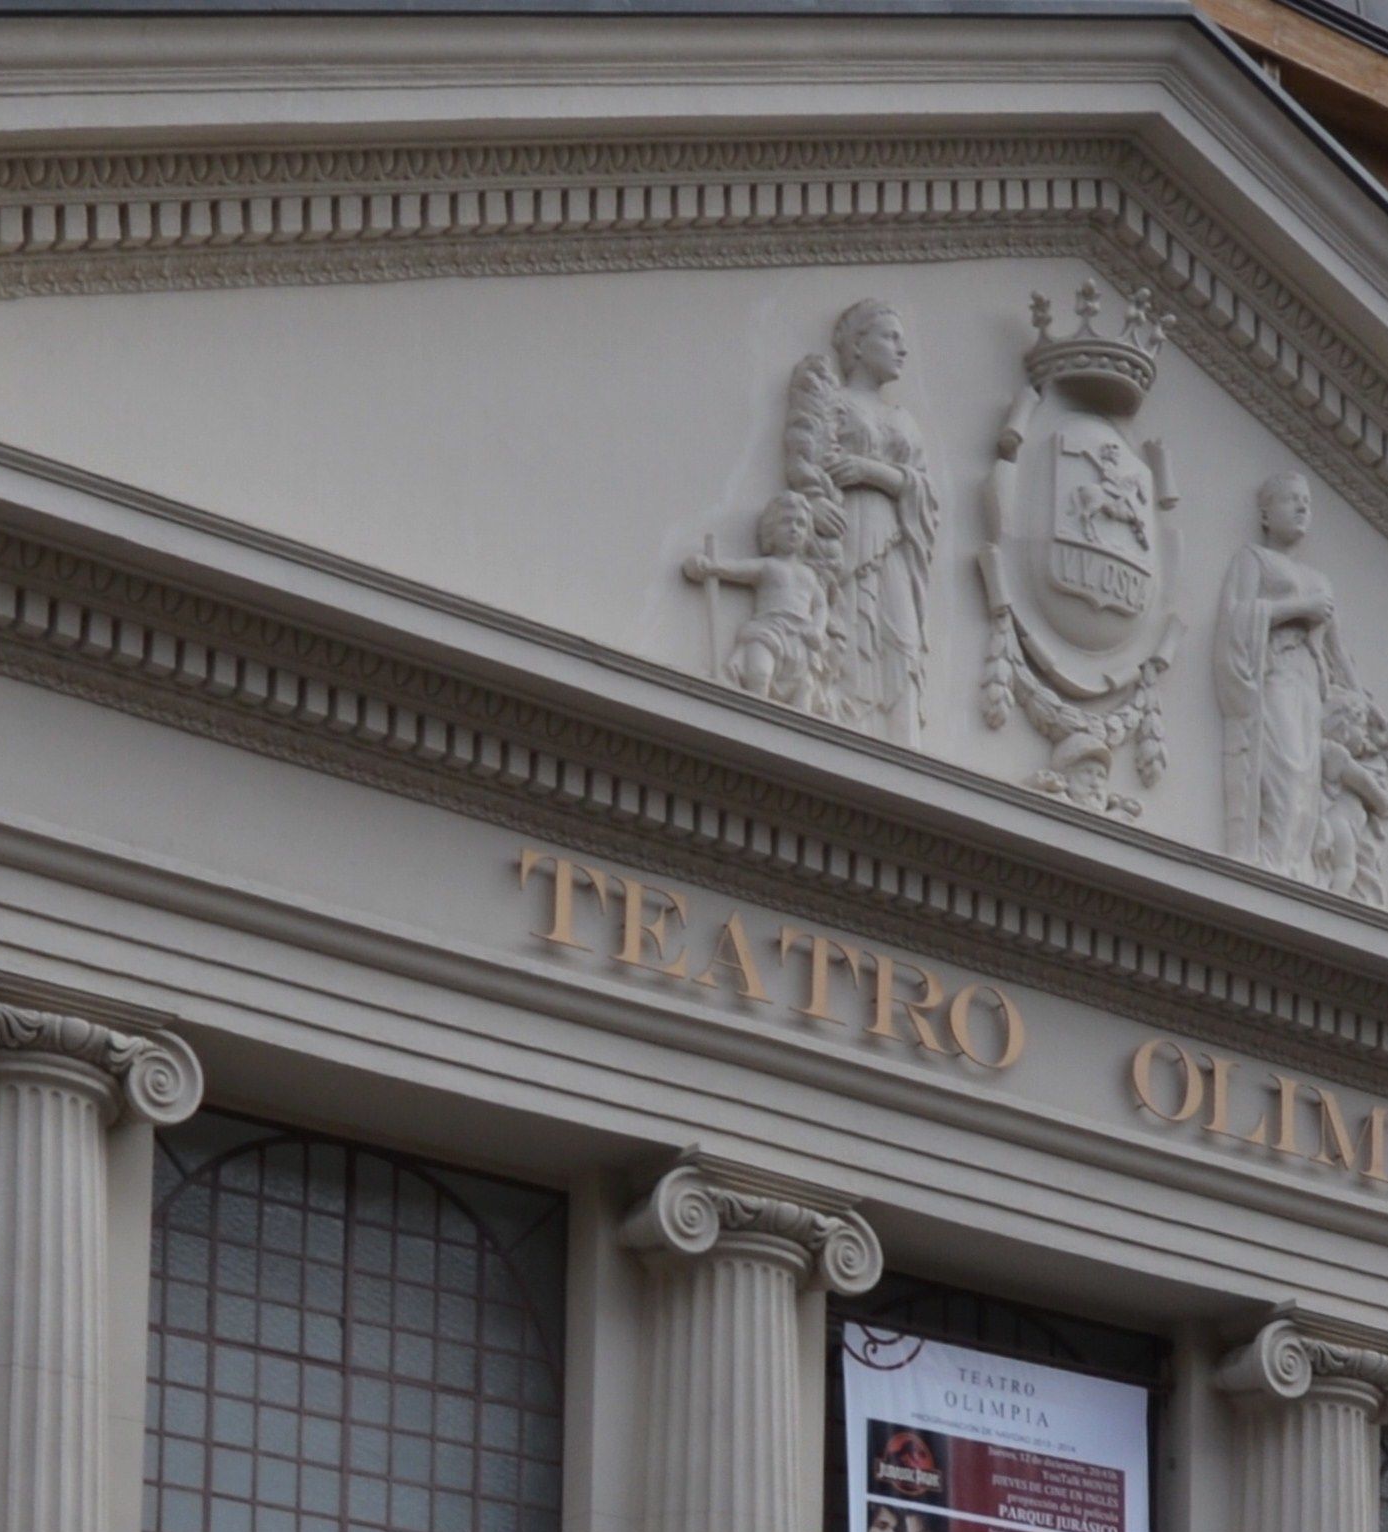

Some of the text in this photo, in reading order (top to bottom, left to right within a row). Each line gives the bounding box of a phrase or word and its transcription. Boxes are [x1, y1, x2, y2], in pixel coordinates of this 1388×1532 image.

[518, 848, 1025, 1070] TEATRO
[957, 1367, 1035, 1397] TEATRO
[944, 1389, 1048, 1428] OLIMPIA
[1029, 1479, 1041, 1494] DE
[1043, 1482, 1067, 1499] CINE
[1069, 1487, 1082, 1502] EN
[998, 1503, 1053, 1528] PARQUE
[1059, 1502, 1071, 1513] de
[1073, 1505, 1081, 1515] la
